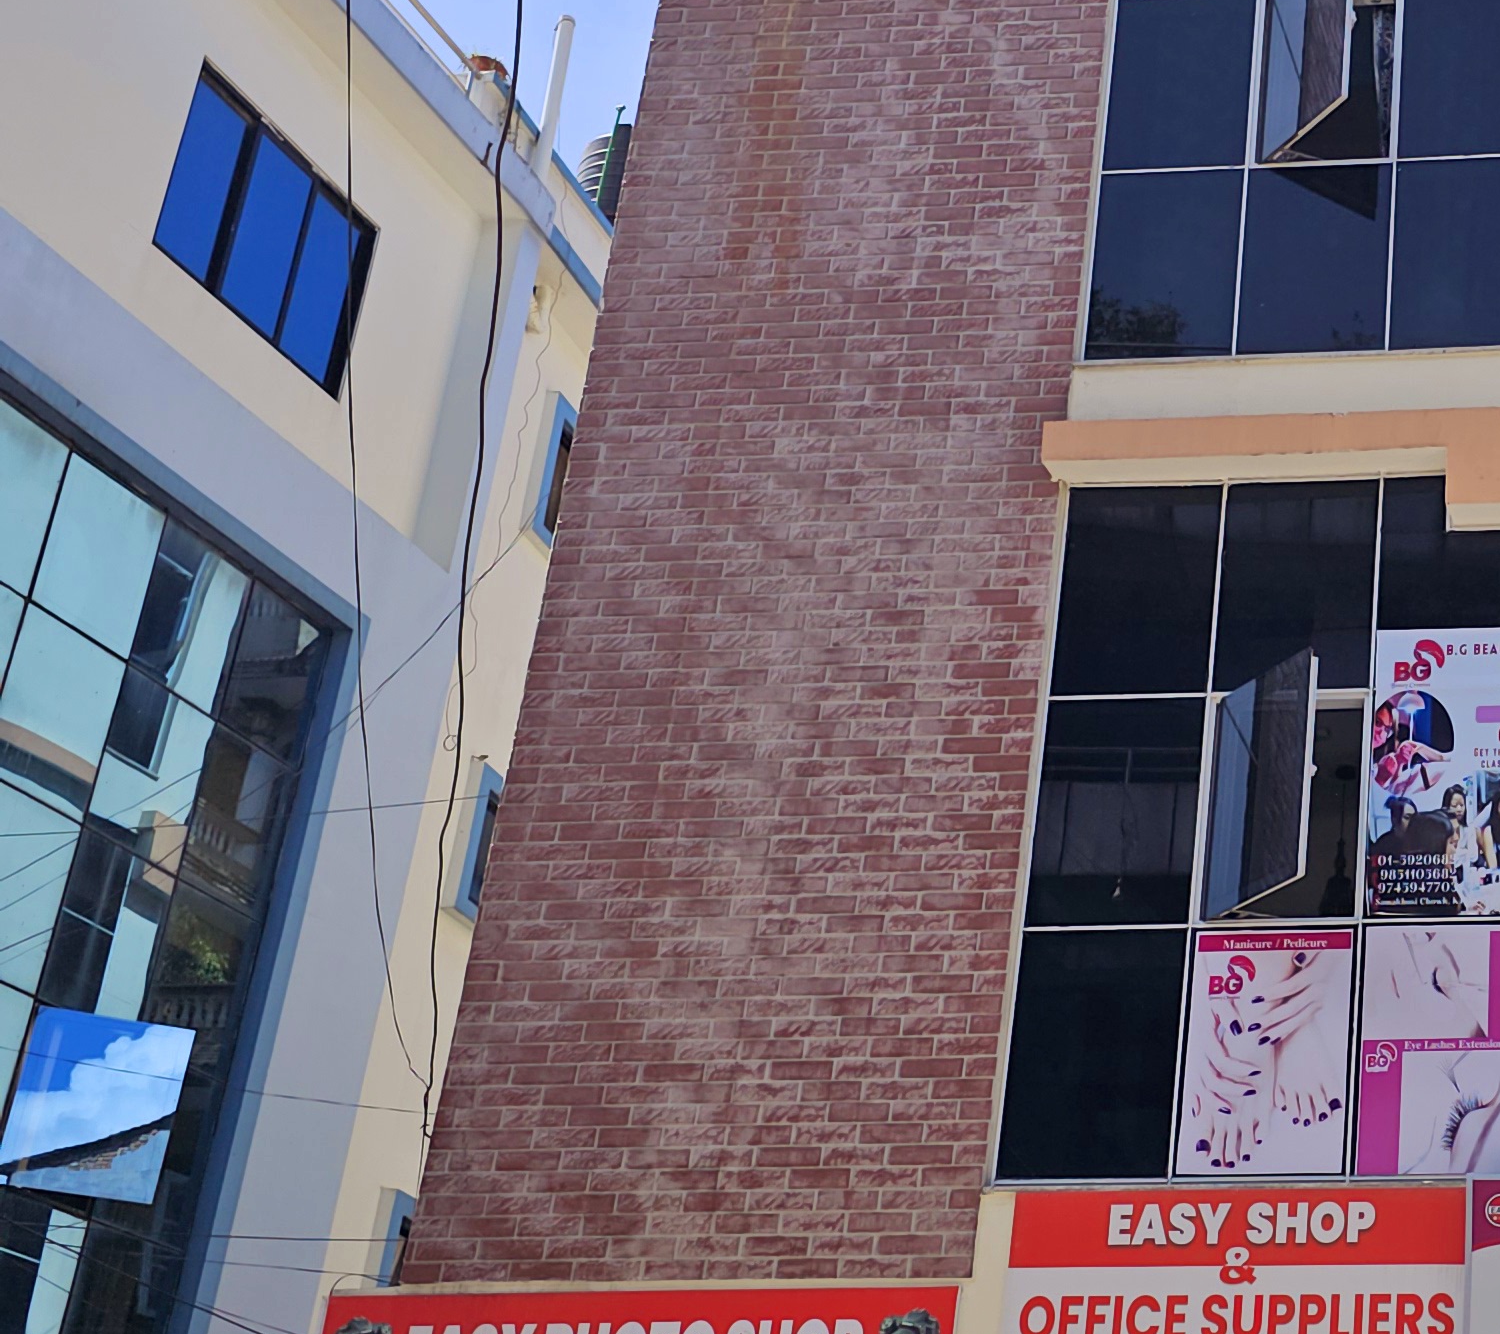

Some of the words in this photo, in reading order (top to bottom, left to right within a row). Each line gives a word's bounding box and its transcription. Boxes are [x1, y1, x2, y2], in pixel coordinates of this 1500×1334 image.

[1446, 644, 1468, 656] B.G
[1223, 938, 1273, 950] Manicure
[1283, 938, 1328, 949] Pedicure
[1404, 1040, 1422, 1051] Eye
[1424, 1040, 1456, 1049] Lashes
[1107, 1202, 1232, 1246] EASY
[1246, 1201, 1377, 1245] SHOP
[1219, 1246, 1257, 1285] &
